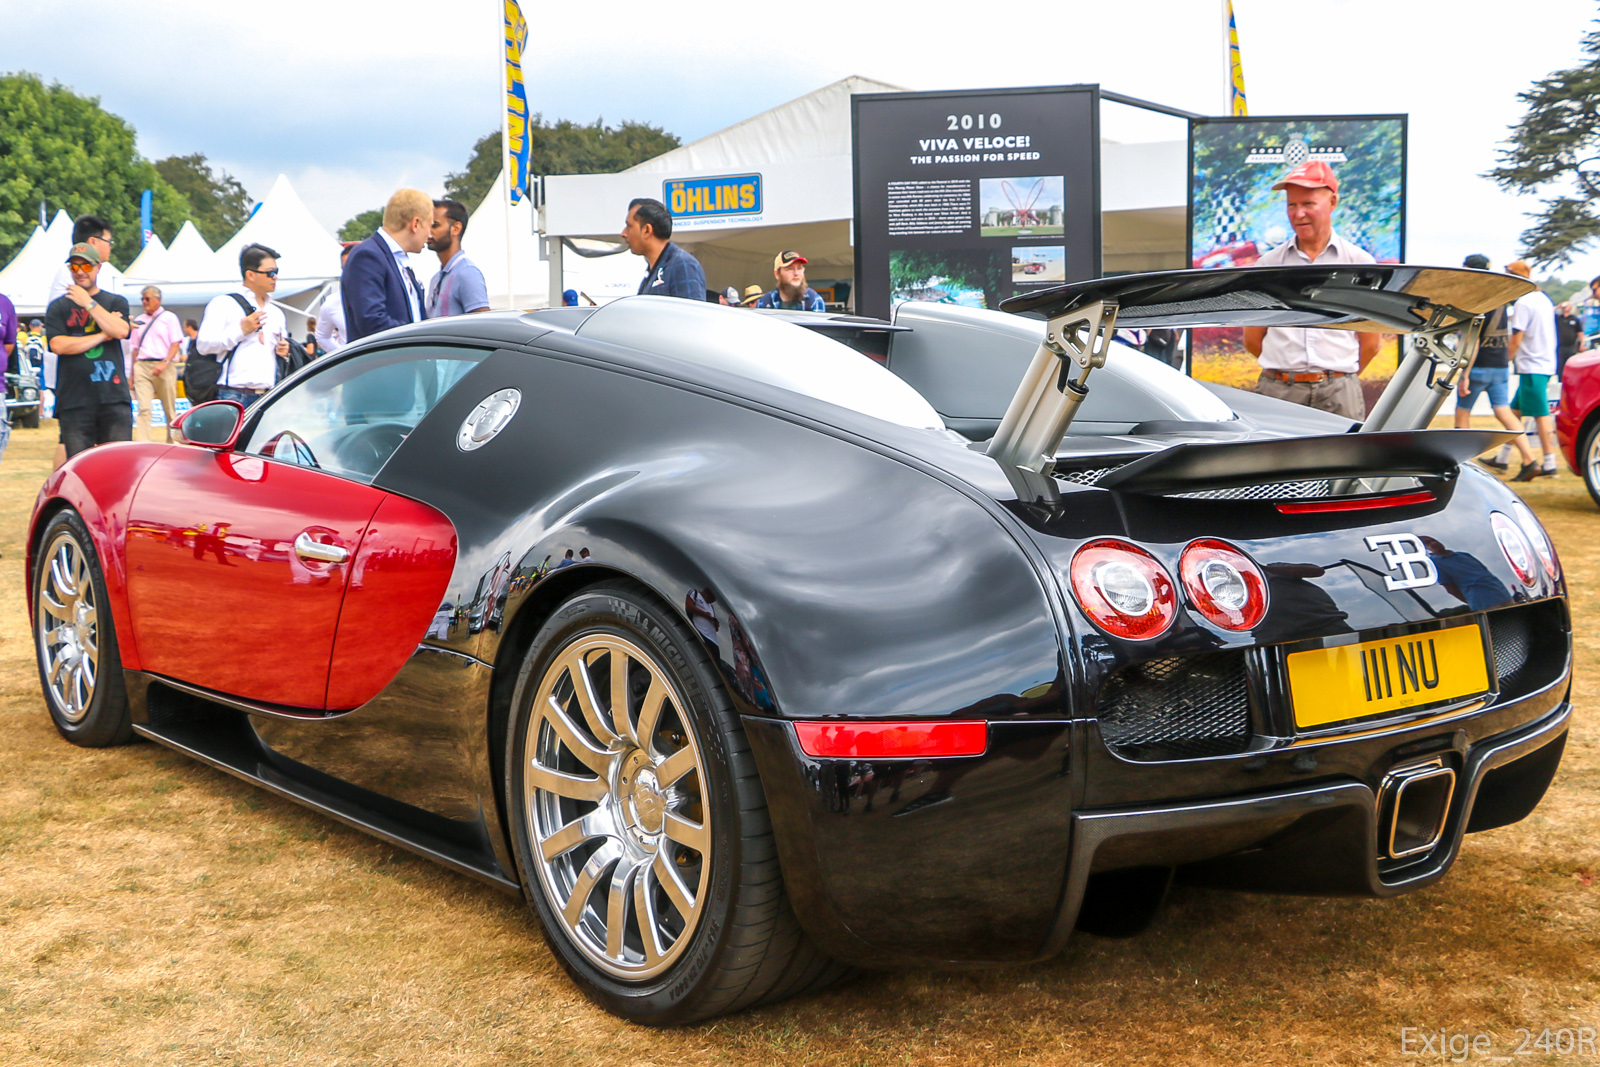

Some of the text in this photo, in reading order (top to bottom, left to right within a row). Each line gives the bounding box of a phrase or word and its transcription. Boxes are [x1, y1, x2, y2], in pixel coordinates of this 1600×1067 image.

[947, 113, 1002, 131] 2010
[918, 135, 1031, 152] VIVA VELOCE!
[910, 151, 1041, 165] THE PASSION FOR SPEED
[671, 183, 756, 213] ÖHLINS
[693, 218, 726, 226] SUSPENSION
[1395, 639, 1440, 695] NU
